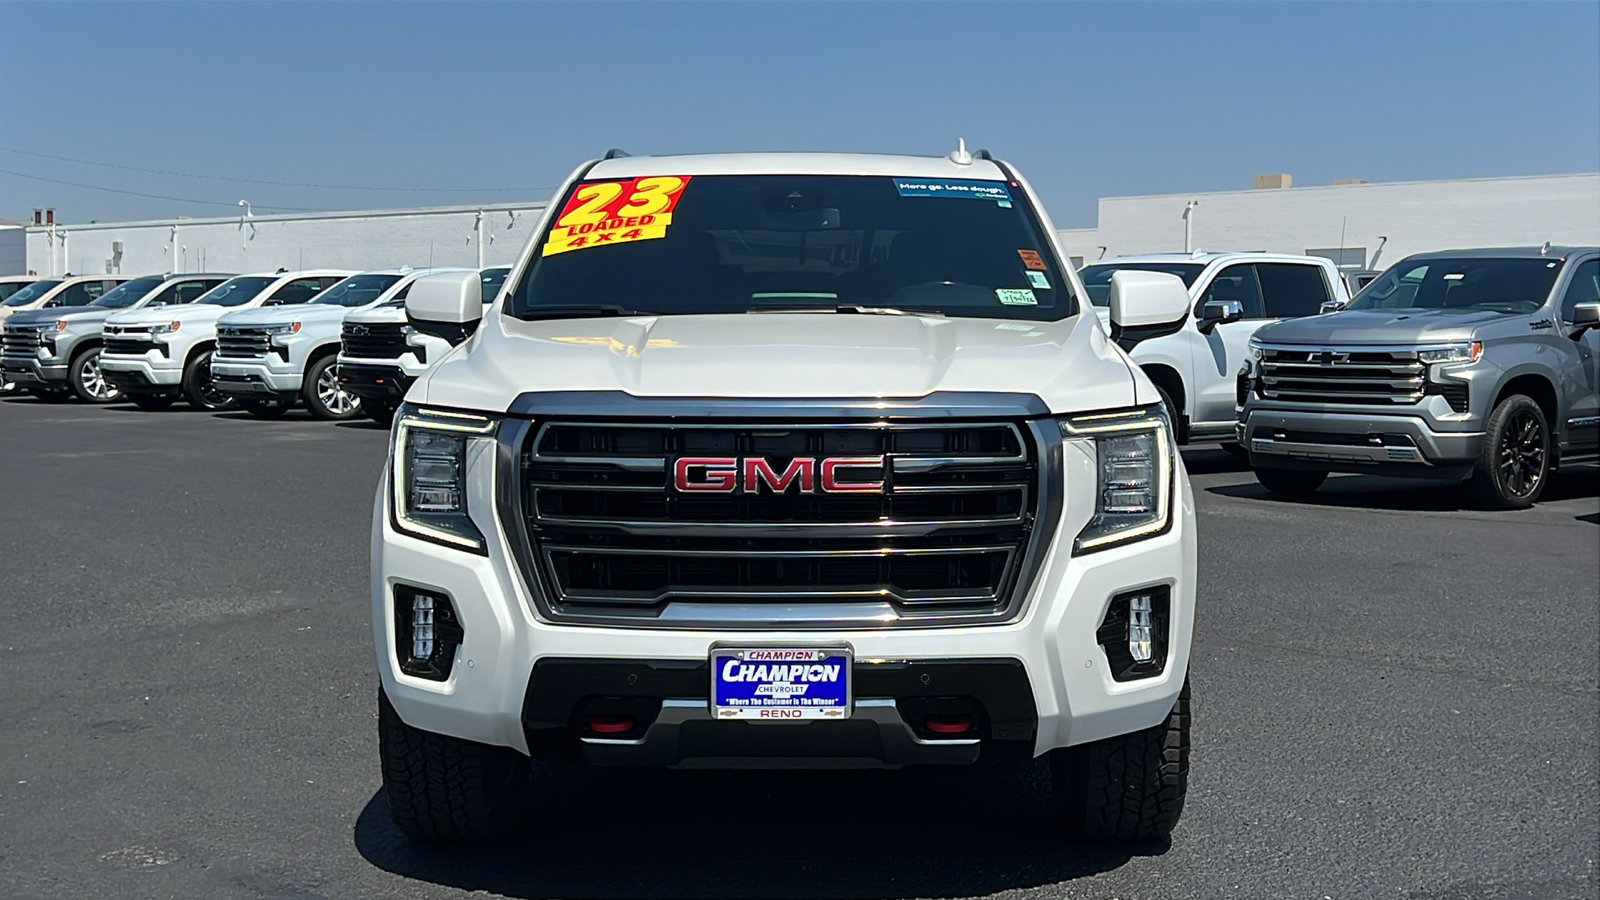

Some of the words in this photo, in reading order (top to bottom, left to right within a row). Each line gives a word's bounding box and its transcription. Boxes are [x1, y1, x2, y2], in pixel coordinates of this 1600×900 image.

[970, 186, 1005, 194] dough.
[558, 176, 684, 227] 23
[567, 215, 656, 237] LOADED
[674, 456, 884, 494] GMC
[749, 651, 813, 660] CHAMPION
[751, 698, 762, 706] The
[763, 698, 792, 706] Customer
[801, 698, 811, 706] The
[760, 709, 802, 718] RENO
